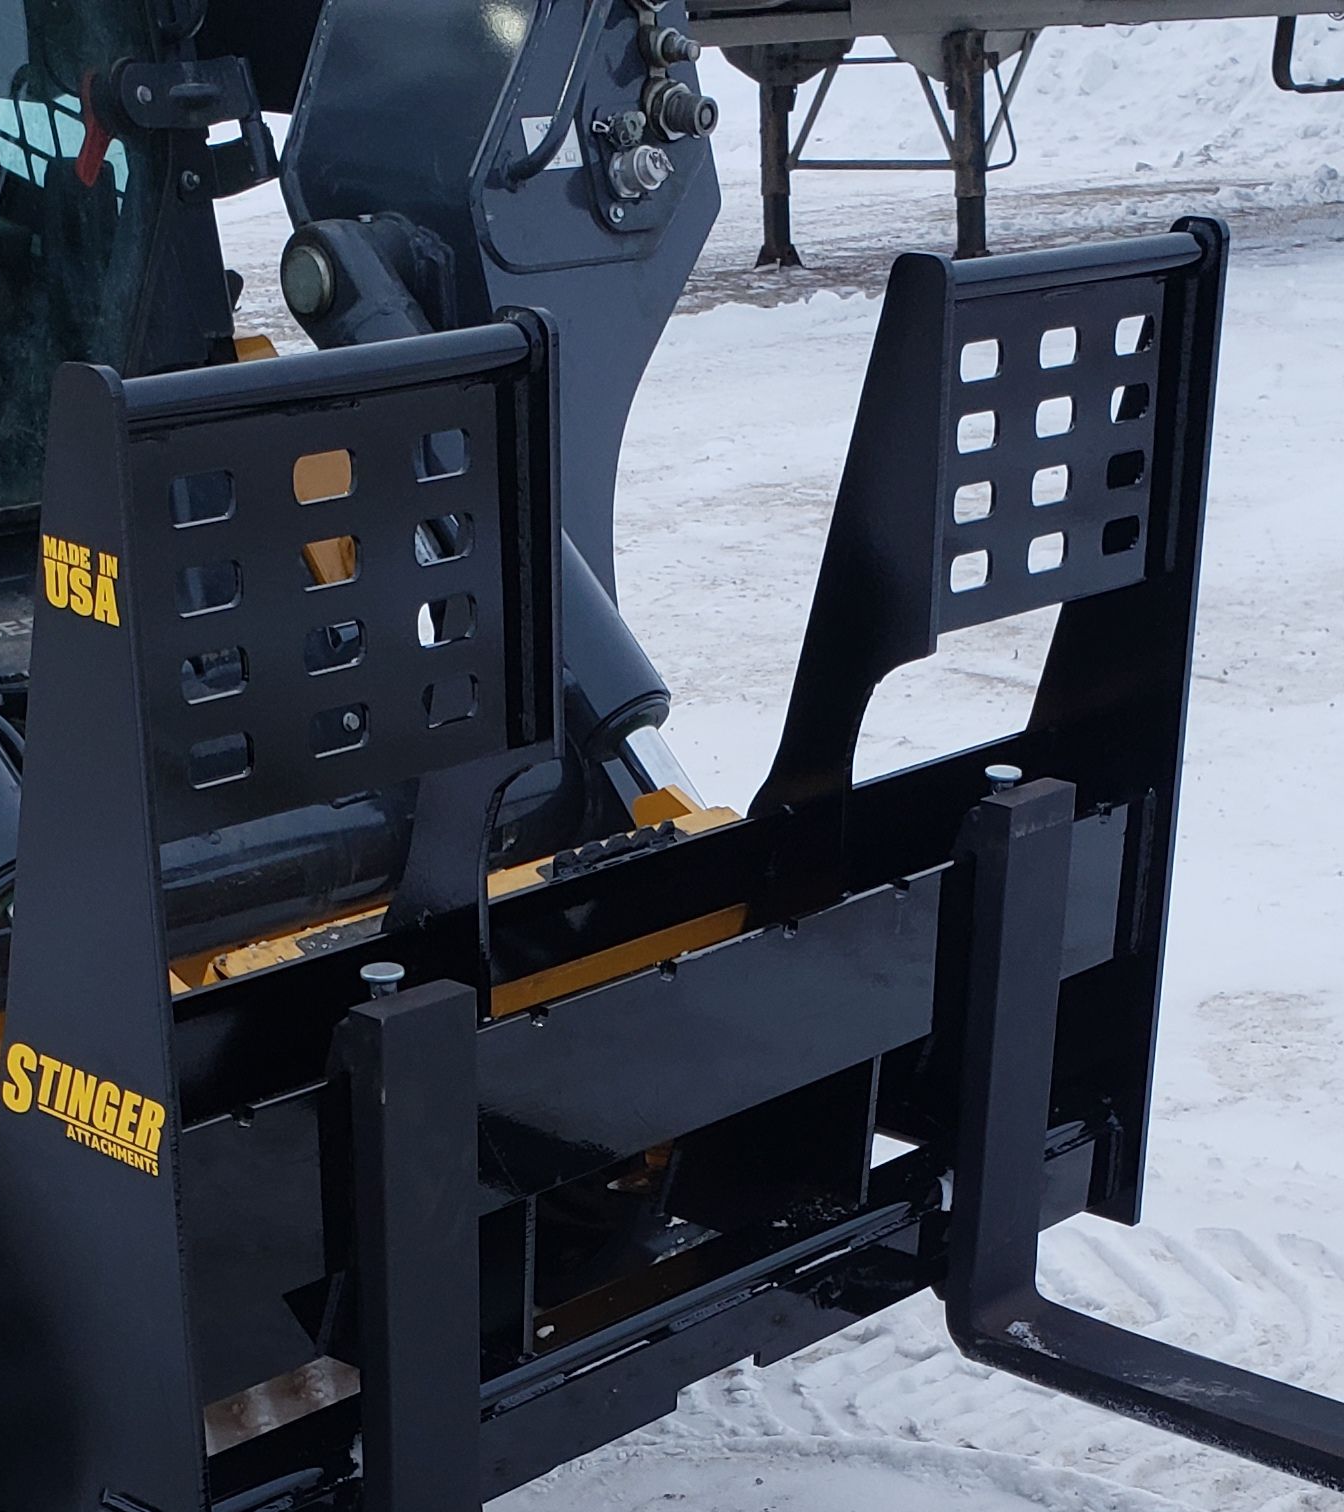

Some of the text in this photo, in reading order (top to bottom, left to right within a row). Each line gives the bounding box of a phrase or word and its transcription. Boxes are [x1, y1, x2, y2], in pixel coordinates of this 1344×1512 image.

[42, 534, 119, 580] MADE IN
[43, 557, 120, 627] USA
[2, 1042, 166, 1153] STINGER
[66, 1124, 159, 1177] ATTACHMENTS
